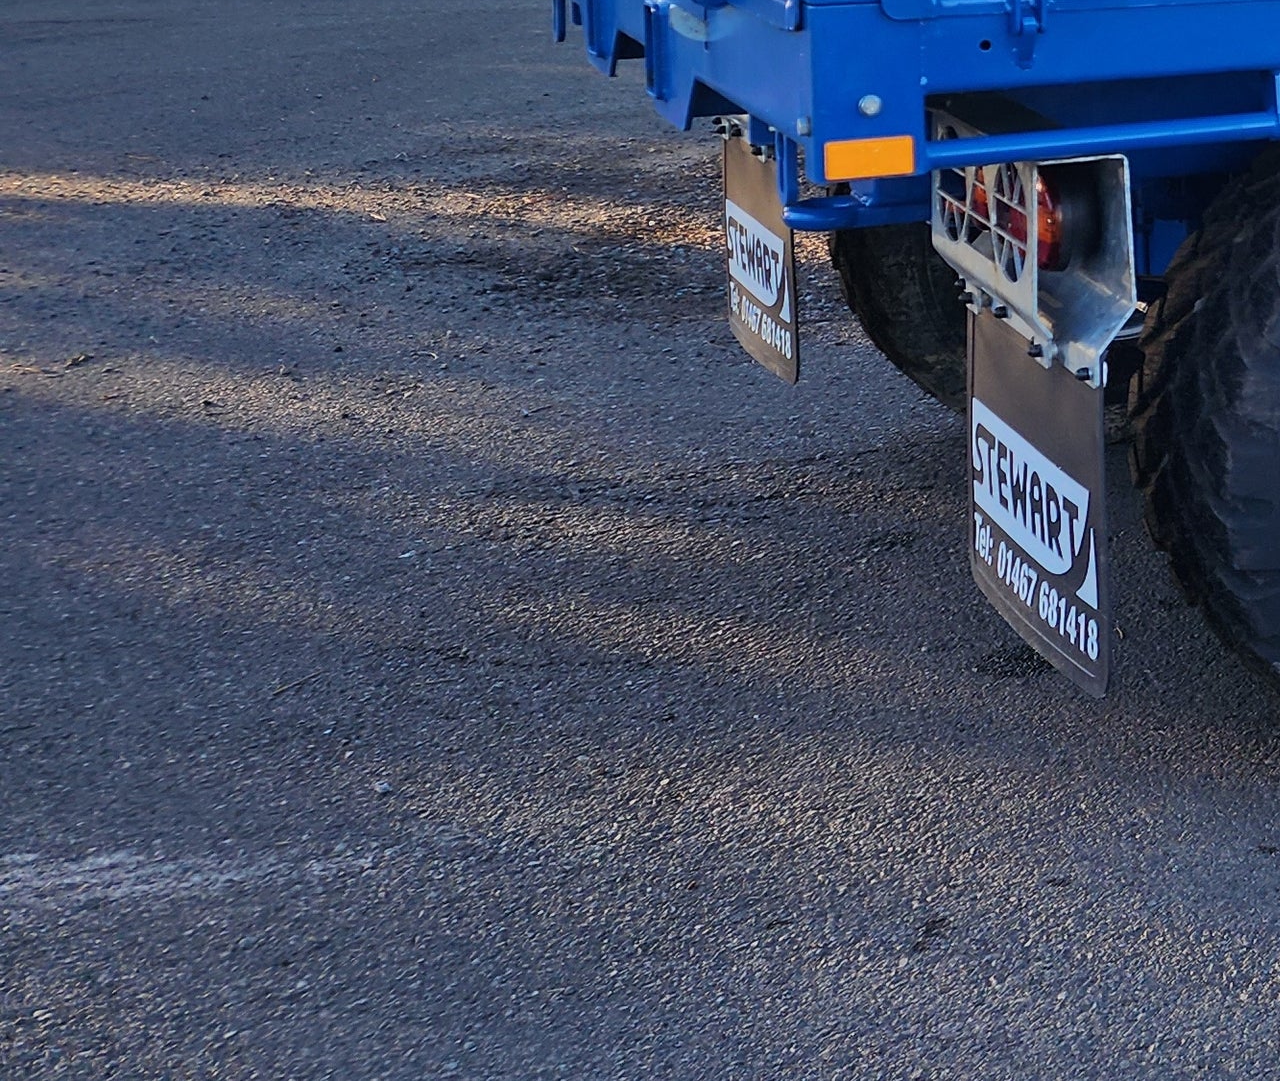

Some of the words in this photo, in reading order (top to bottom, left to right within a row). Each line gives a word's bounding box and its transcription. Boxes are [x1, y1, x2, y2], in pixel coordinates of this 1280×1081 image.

[727, 211, 786, 307] STEWART
[741, 295, 762, 335] 01467
[760, 313, 793, 360] 681418
[973, 422, 1092, 587] STEWART
[973, 511, 995, 567] Tel:
[996, 540, 1039, 608] 01467
[1037, 579, 1099, 661] 681418
